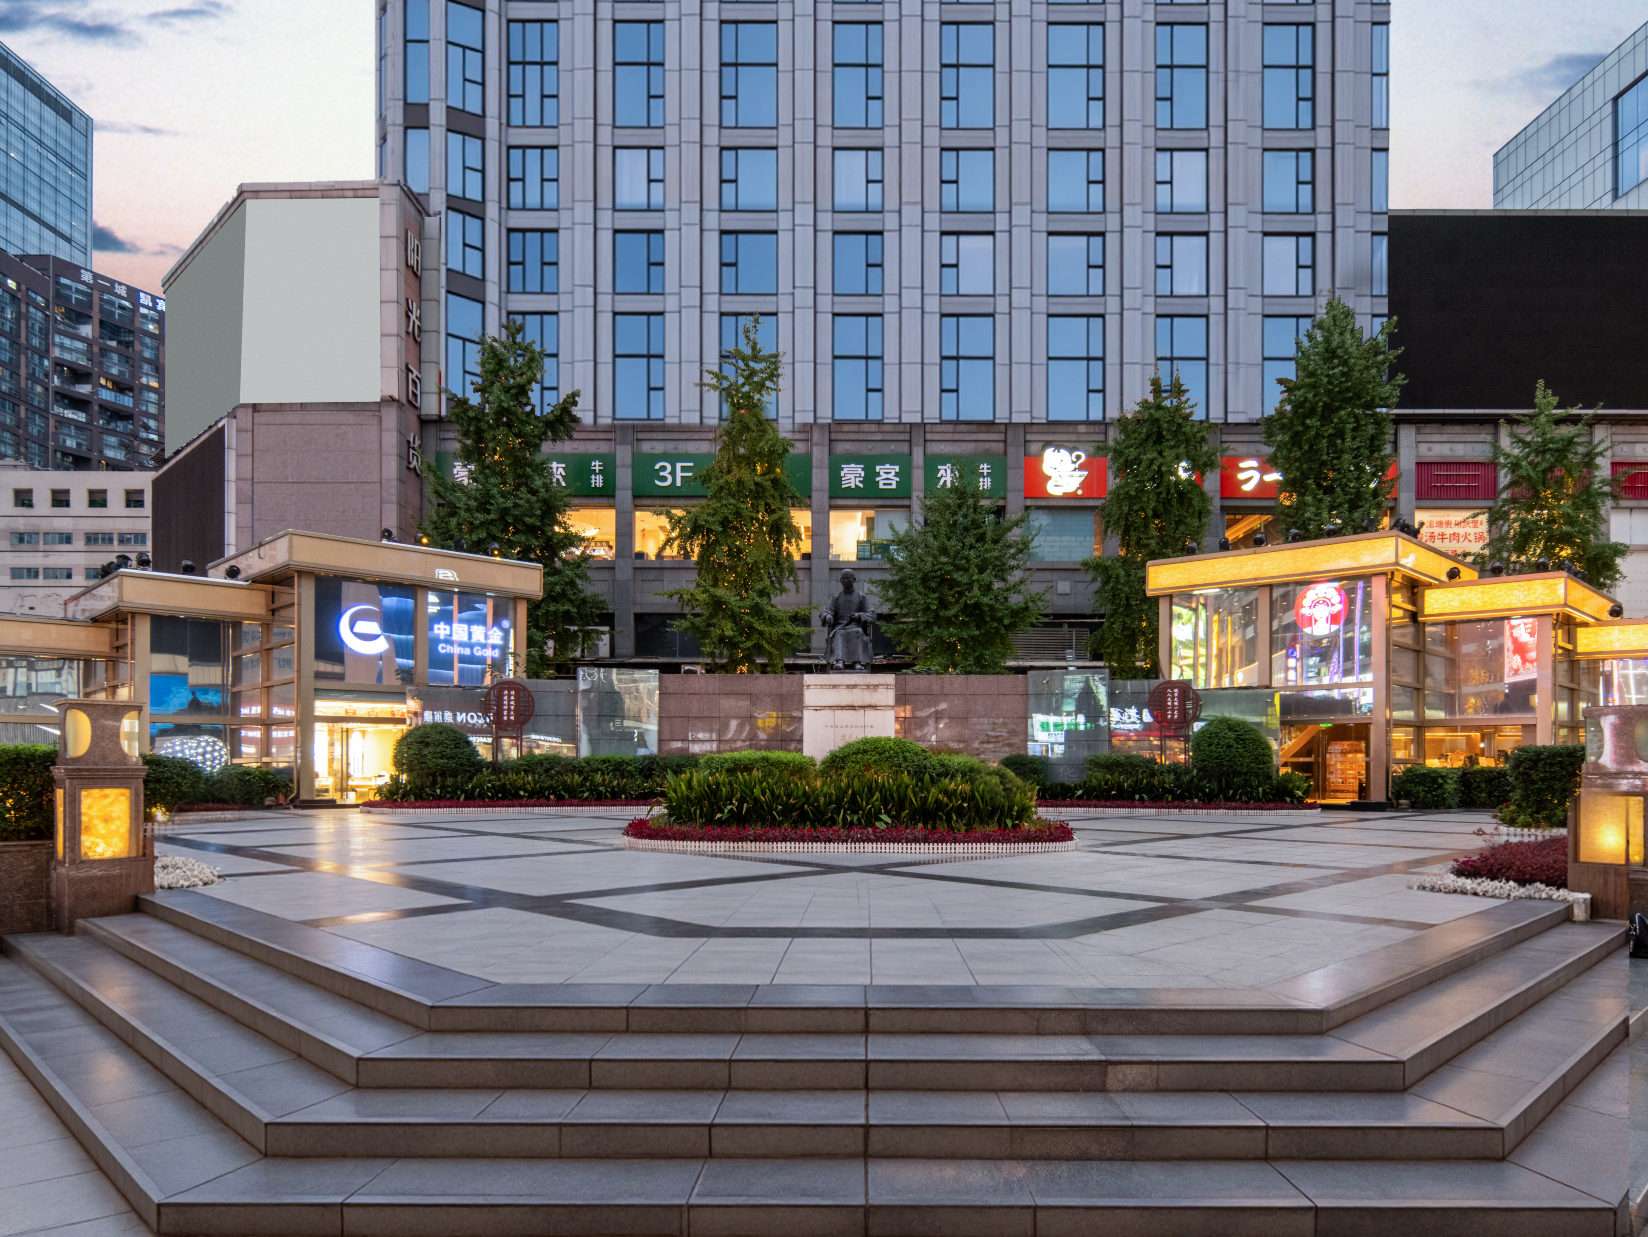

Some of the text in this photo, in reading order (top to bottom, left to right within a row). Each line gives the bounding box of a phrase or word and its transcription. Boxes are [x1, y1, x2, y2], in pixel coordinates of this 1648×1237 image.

[80, 268, 128, 298] 第一城
[406, 228, 422, 476] 阳光百货
[590, 459, 604, 488] 牛排
[654, 461, 694, 487] 3F
[978, 462, 992, 491] 牛排
[433, 621, 504, 645] 中国黄金
[437, 643, 499, 658] China Gold
